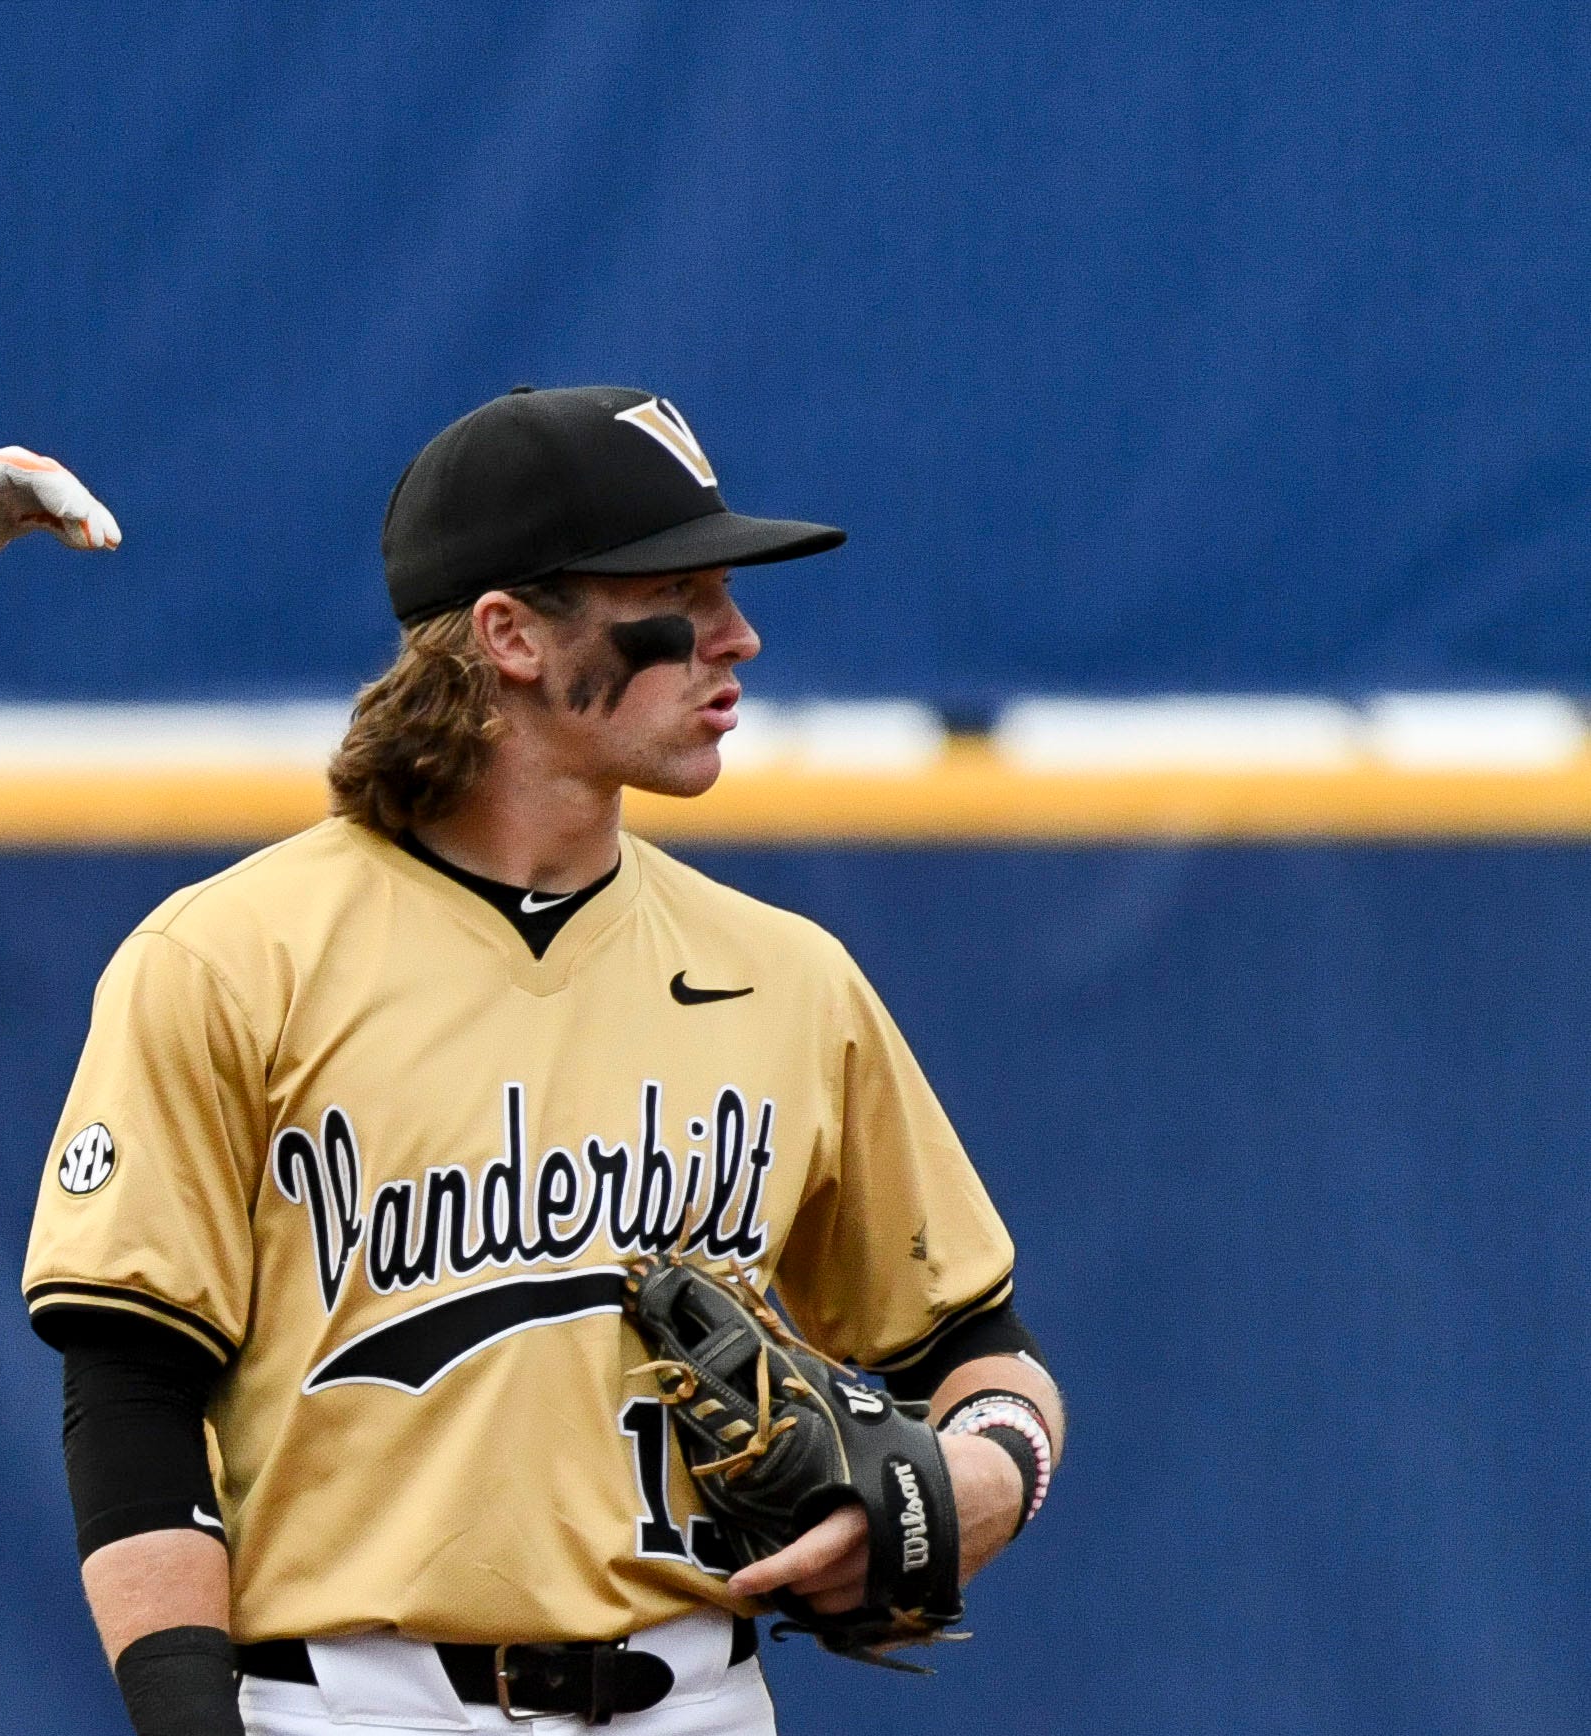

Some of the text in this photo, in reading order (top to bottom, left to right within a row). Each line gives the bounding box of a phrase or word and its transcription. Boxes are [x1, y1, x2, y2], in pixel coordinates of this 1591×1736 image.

[614, 397, 718, 488] V
[58, 1122, 115, 1194] SEC
[273, 1078, 775, 1315] Vanderbilt
[893, 1462, 930, 1573] Wilson
